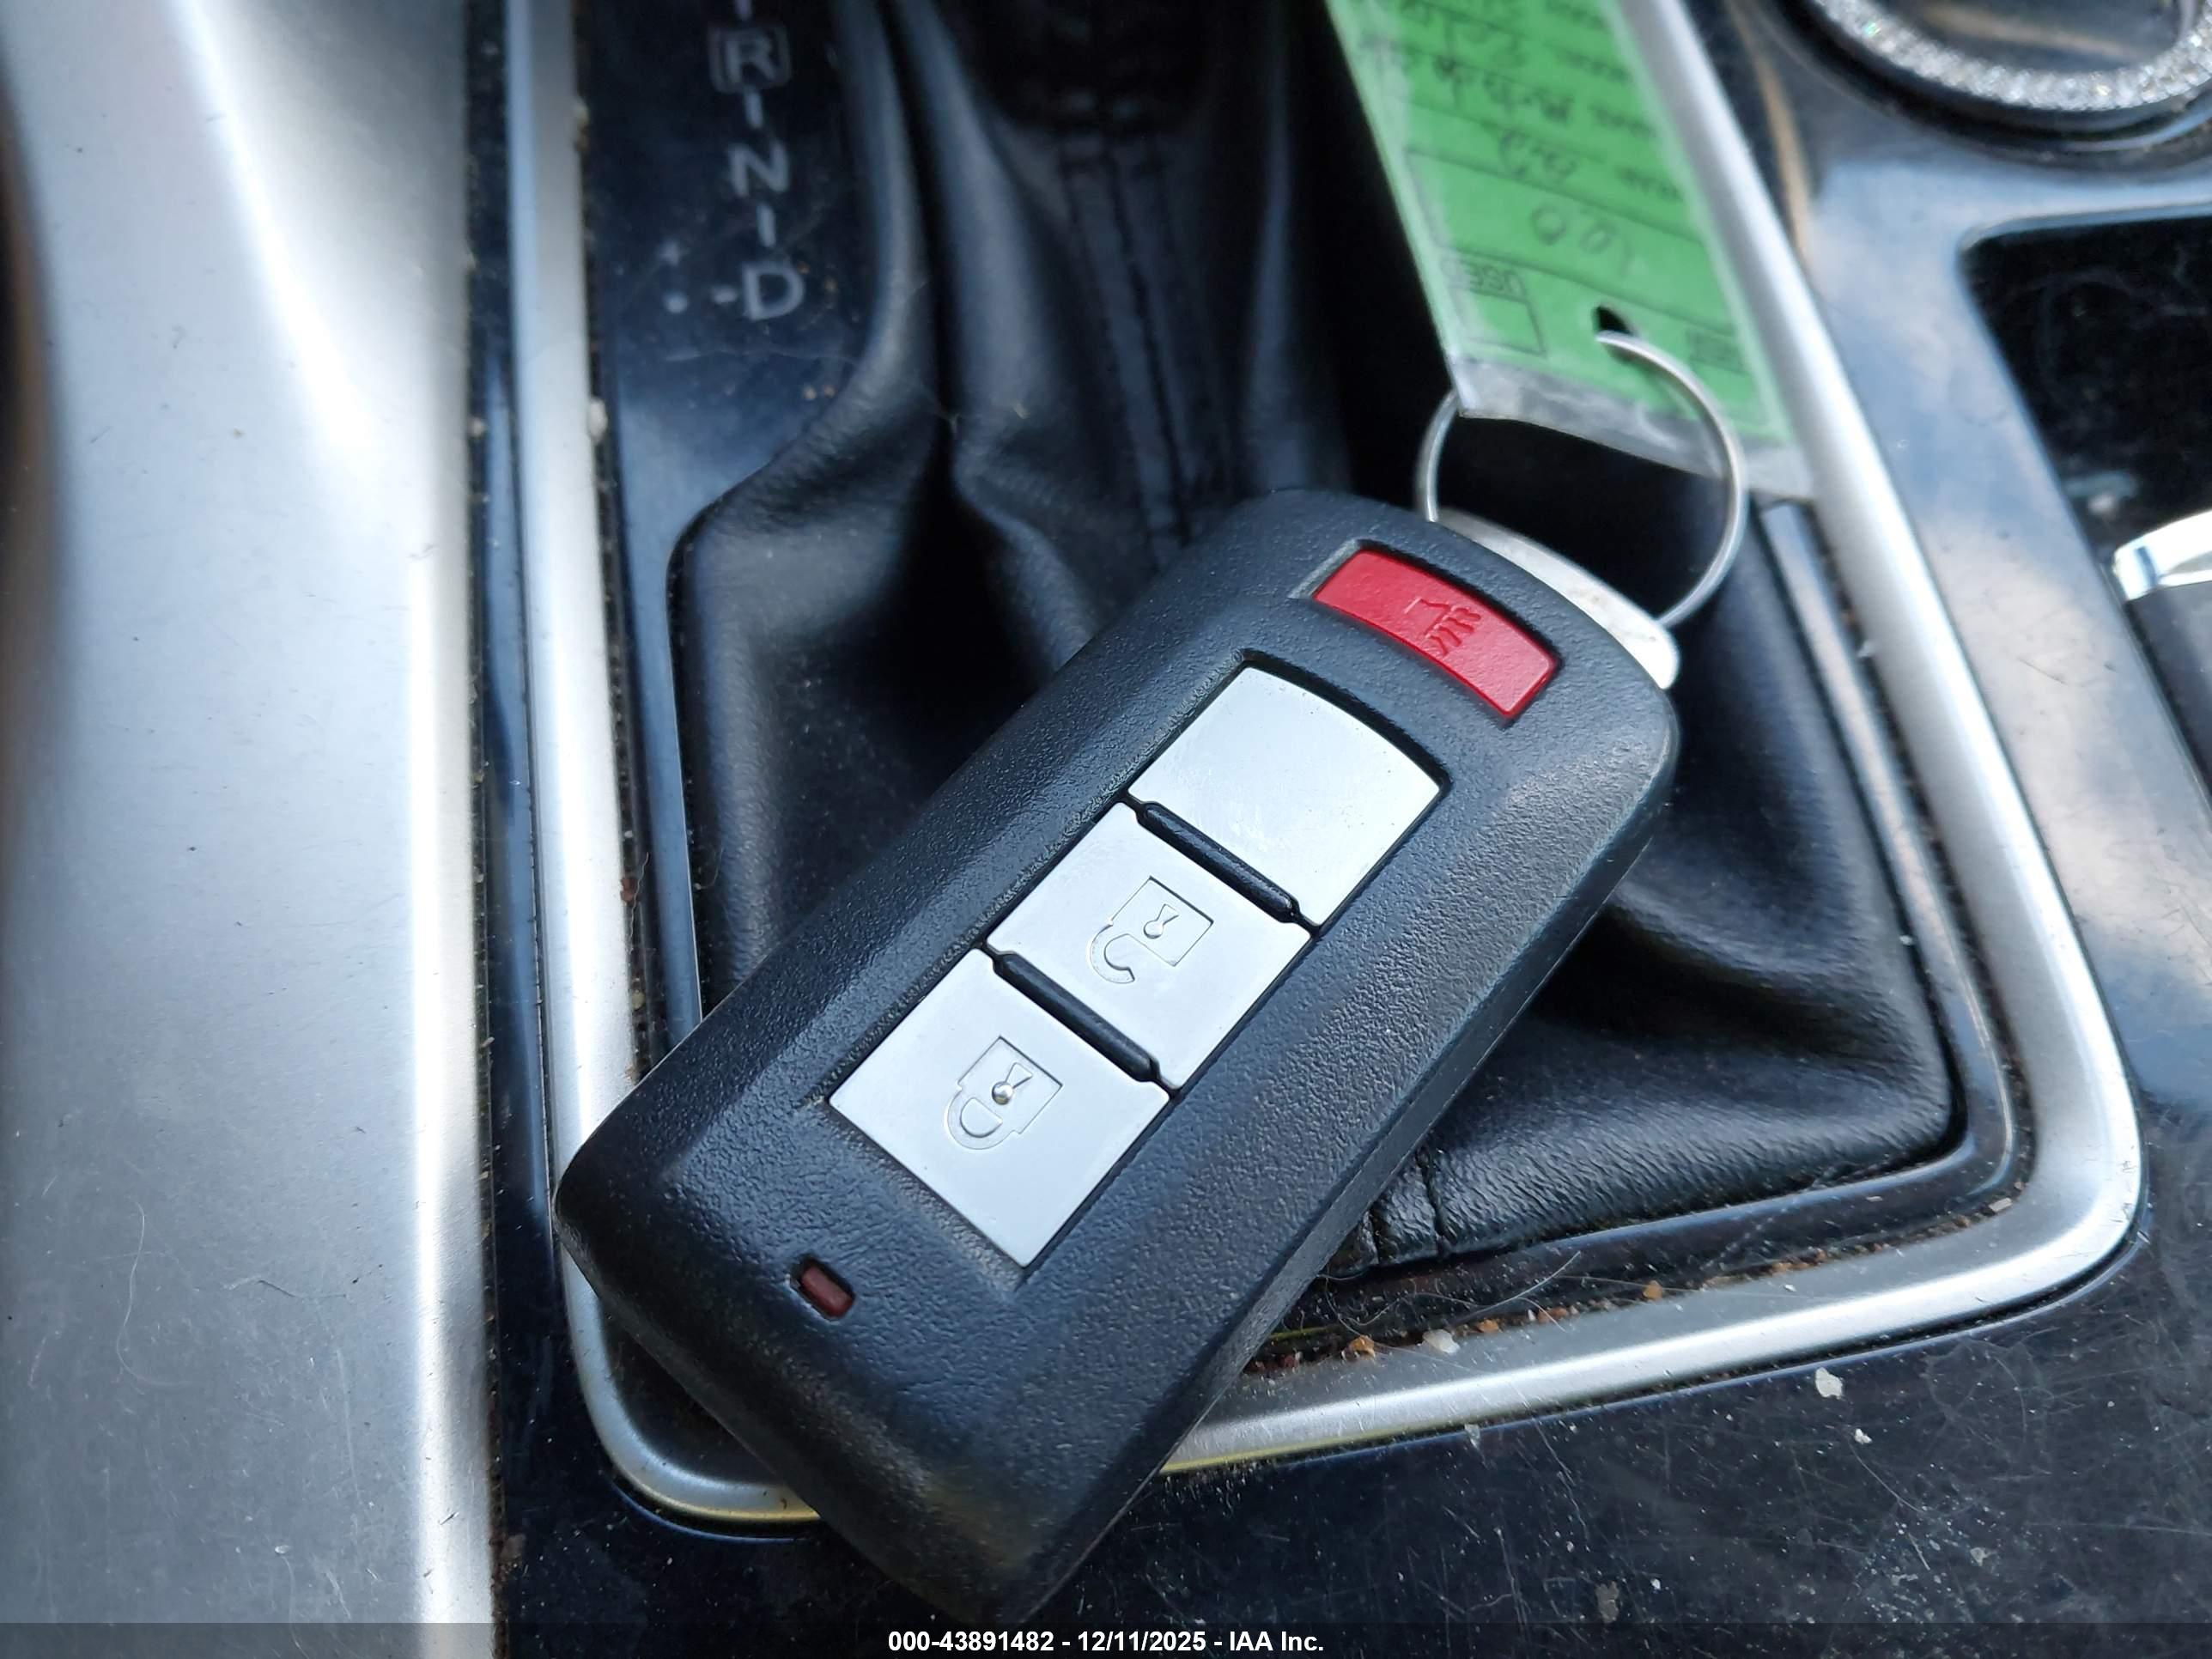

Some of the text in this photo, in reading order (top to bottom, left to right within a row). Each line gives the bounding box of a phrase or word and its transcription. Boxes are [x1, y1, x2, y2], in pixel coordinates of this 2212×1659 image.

[725, 28, 777, 84] R
[728, 138, 789, 198] N
[741, 260, 805, 321] D
